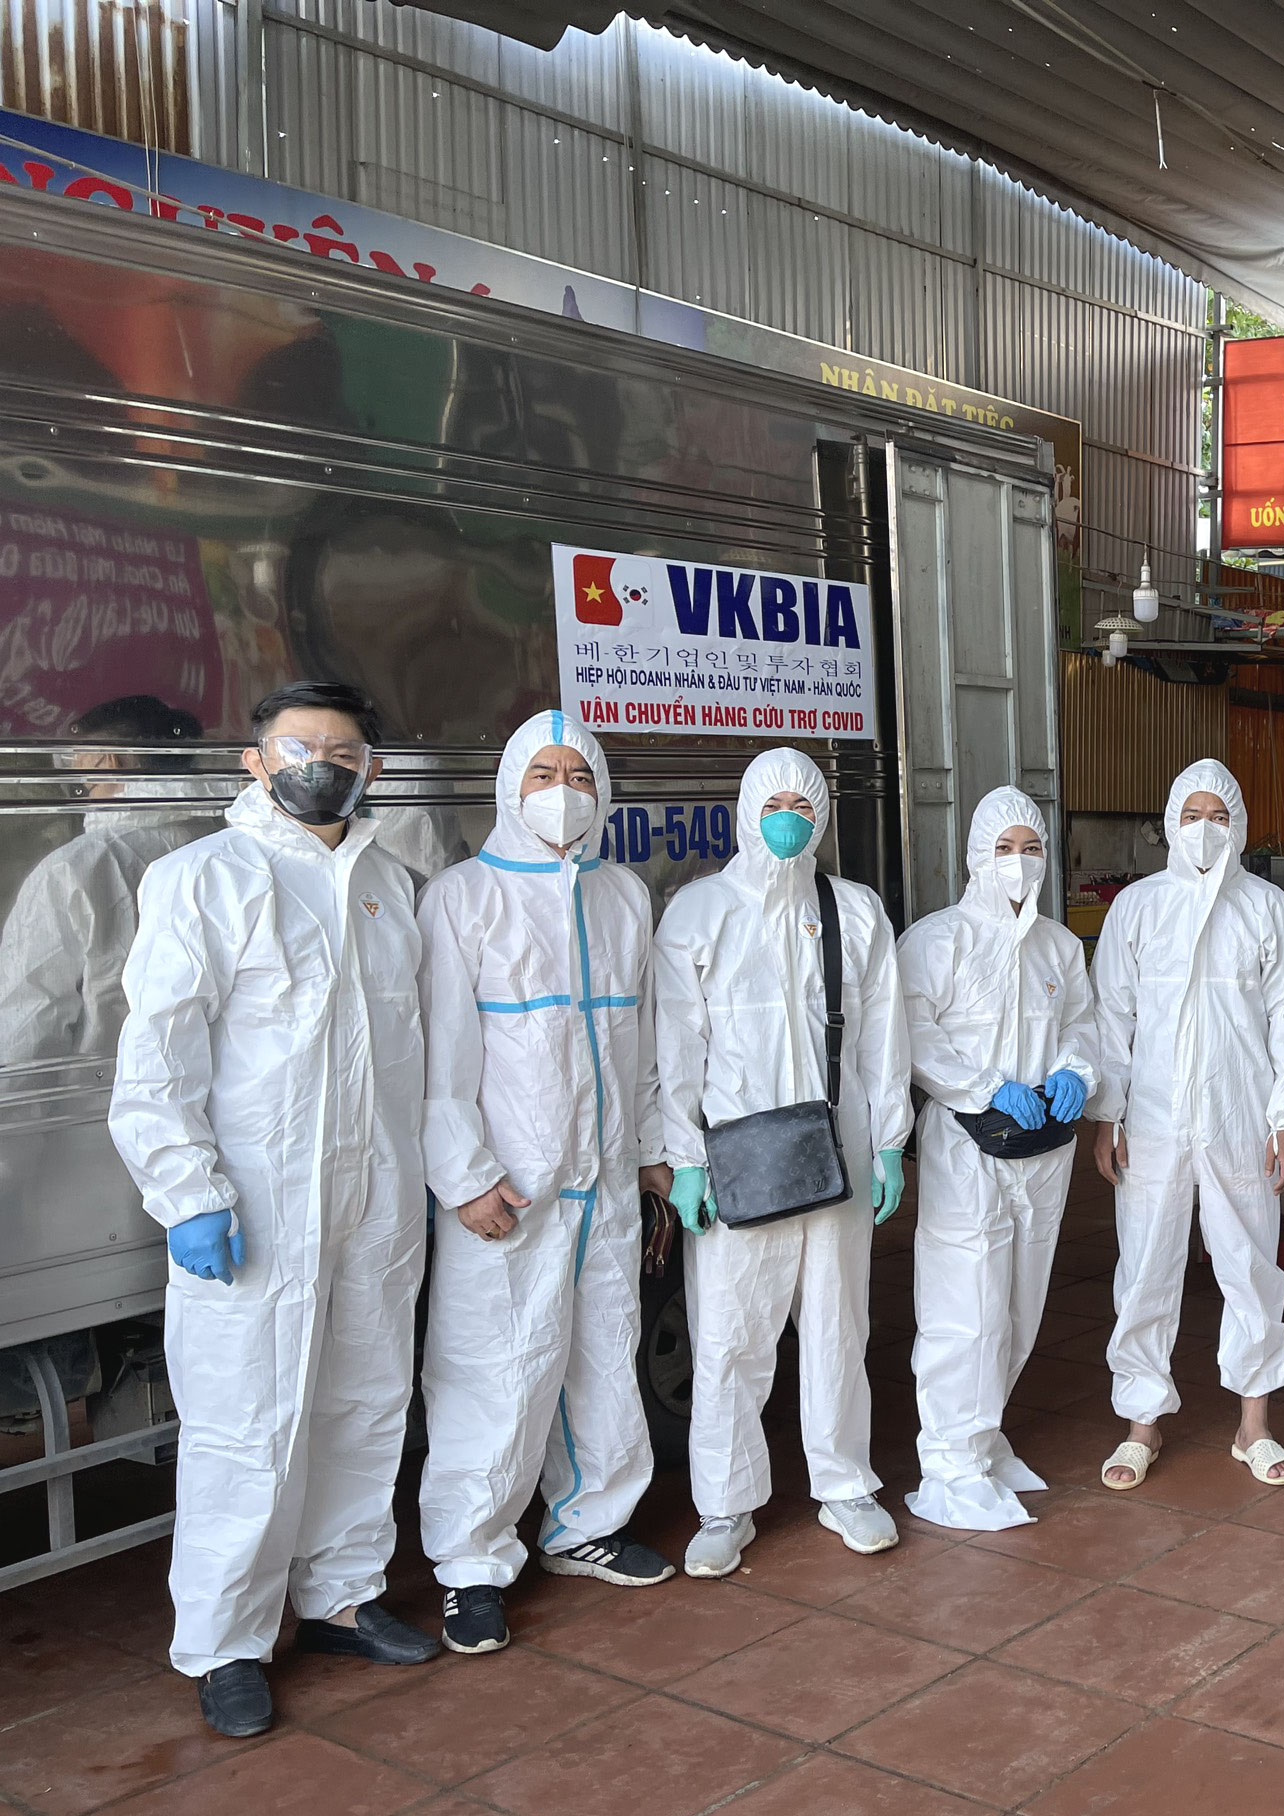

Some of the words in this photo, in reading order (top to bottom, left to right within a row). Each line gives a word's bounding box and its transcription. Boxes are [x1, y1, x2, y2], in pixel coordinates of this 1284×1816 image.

[666, 564, 860, 650] VKBIA
[576, 666, 603, 690] HIỆP
[607, 665, 627, 686] HỘI
[631, 671, 672, 688] DOANH
[675, 670, 705, 690] NHÂN
[708, 678, 716, 690] &
[718, 671, 740, 691] ĐẦU
[744, 675, 758, 691] TƯ
[761, 676, 781, 696] VIỆT
[784, 680, 805, 694] NAM
[814, 678, 832, 696] HÀN
[835, 679, 862, 698] QUỐC
[580, 696, 619, 728] VẬN
[626, 696, 696, 726] CHUYỂN
[702, 698, 748, 728] HÀNG
[752, 704, 784, 728] CỨU
[788, 708, 818, 734] TRỢ
[822, 711, 864, 731] COVID
